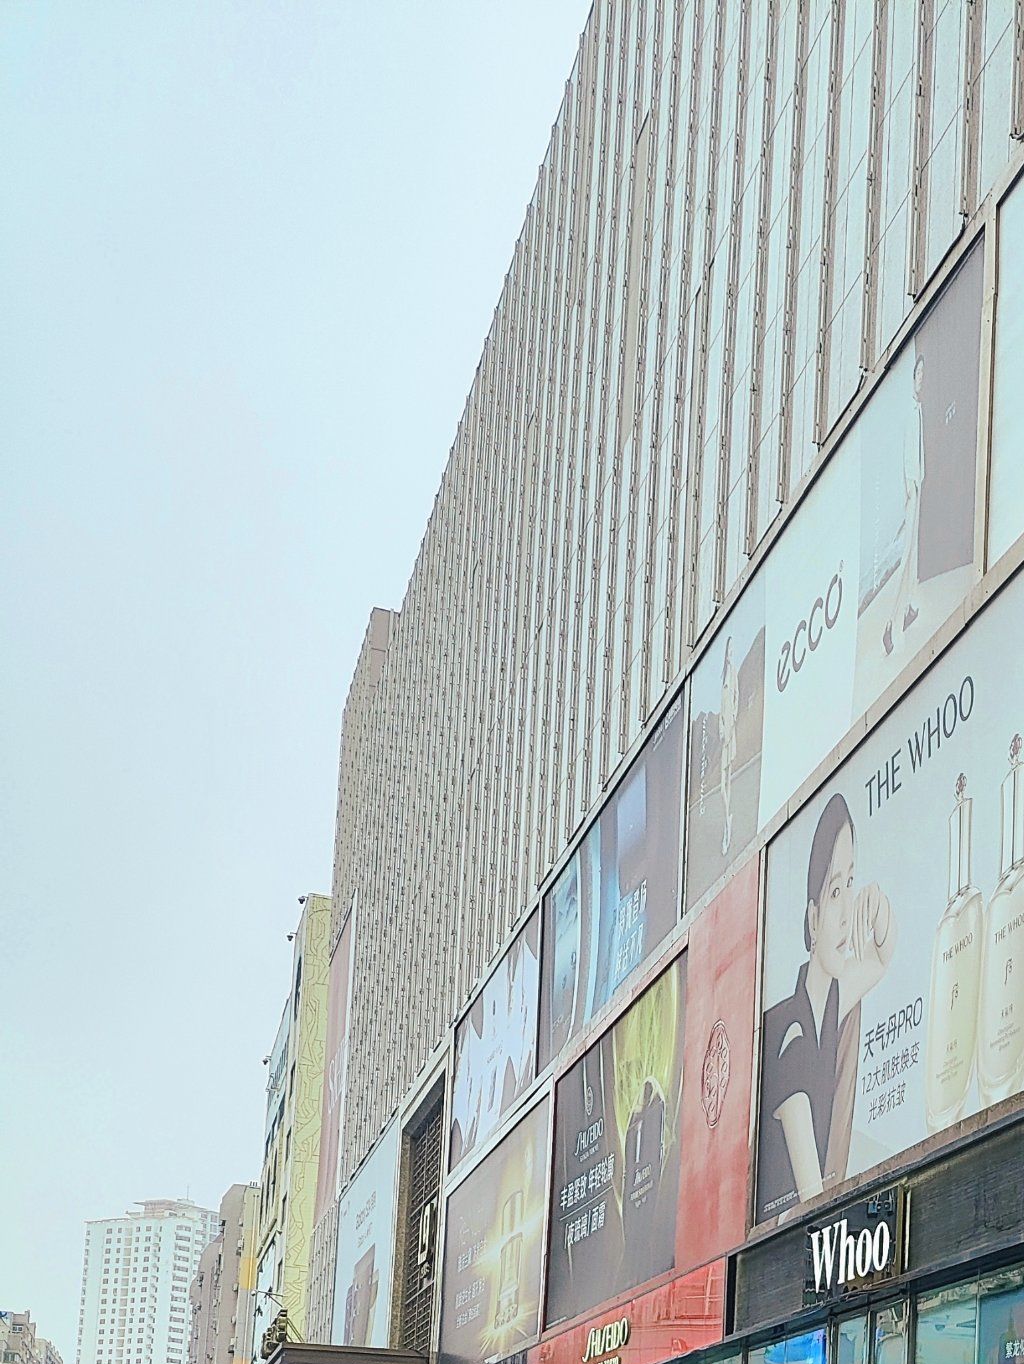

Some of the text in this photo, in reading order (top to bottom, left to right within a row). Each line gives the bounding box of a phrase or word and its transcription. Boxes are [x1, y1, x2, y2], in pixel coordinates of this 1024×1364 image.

[776, 573, 843, 692] ecco
[864, 675, 975, 818] THE WHOO
[994, 924, 1007, 945] THE
[863, 996, 924, 1063] 天气丹PRO
[574, 1118, 604, 1156] SHISEIDO
[810, 1218, 891, 1296] Whoo
[582, 1317, 629, 1363] SHISEIDO
